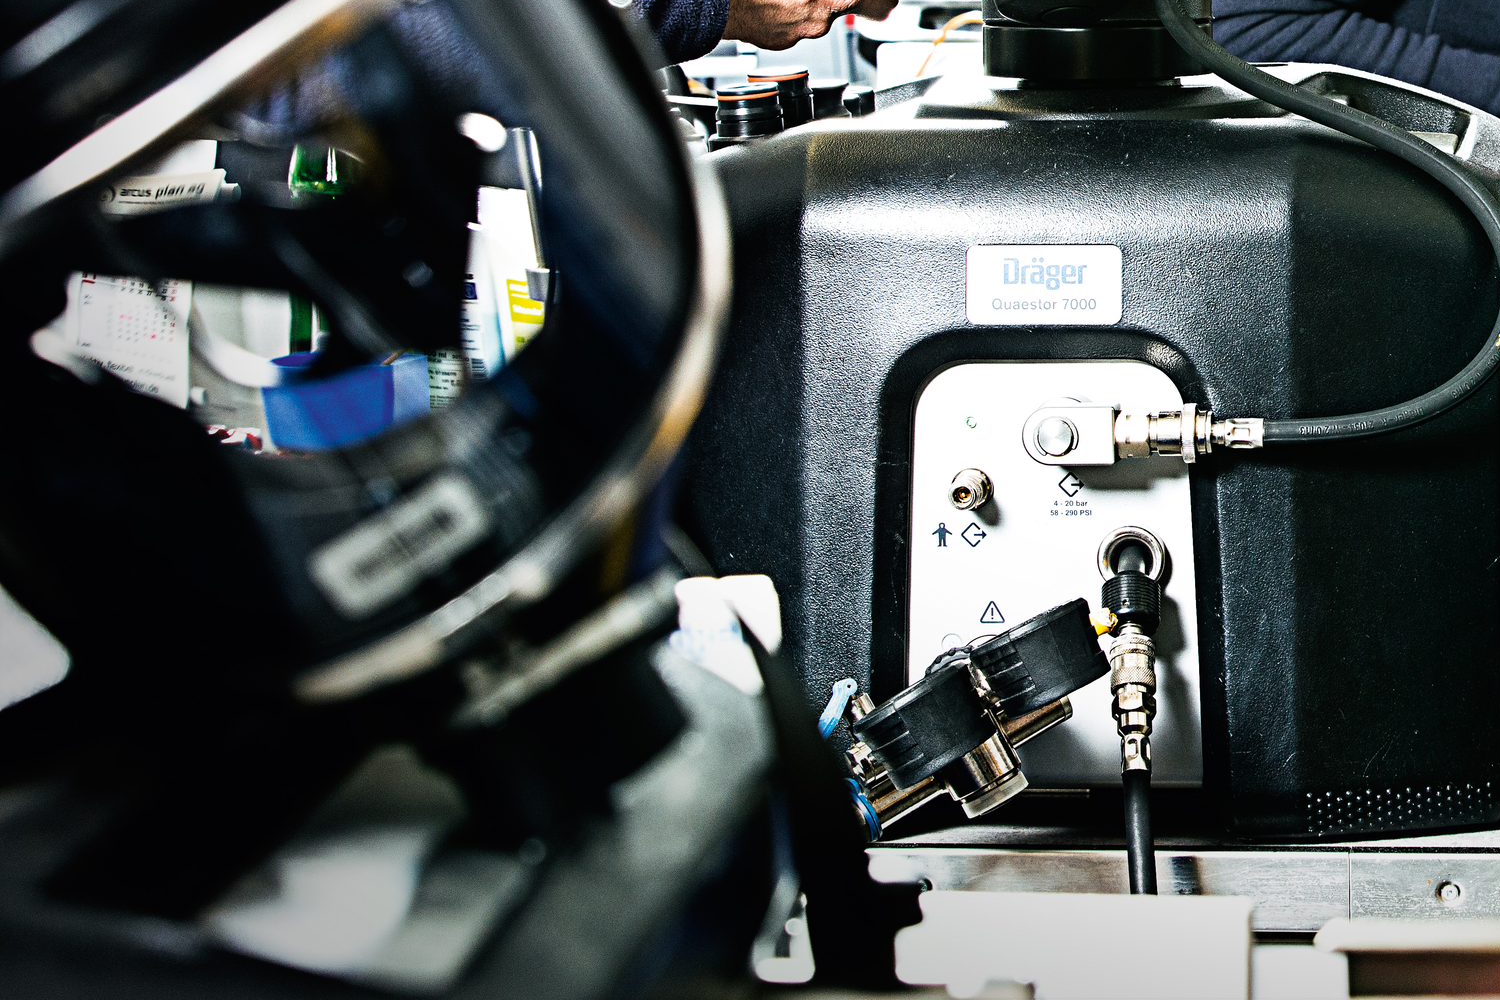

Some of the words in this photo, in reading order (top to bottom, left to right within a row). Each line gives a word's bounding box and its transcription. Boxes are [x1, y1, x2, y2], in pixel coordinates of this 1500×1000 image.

[119, 187, 152, 198] arcus
[154, 183, 185, 201] plan
[1003, 257, 1088, 290] Dräger
[991, 298, 1058, 311] Quaestor
[1061, 298, 1097, 311] 7000
